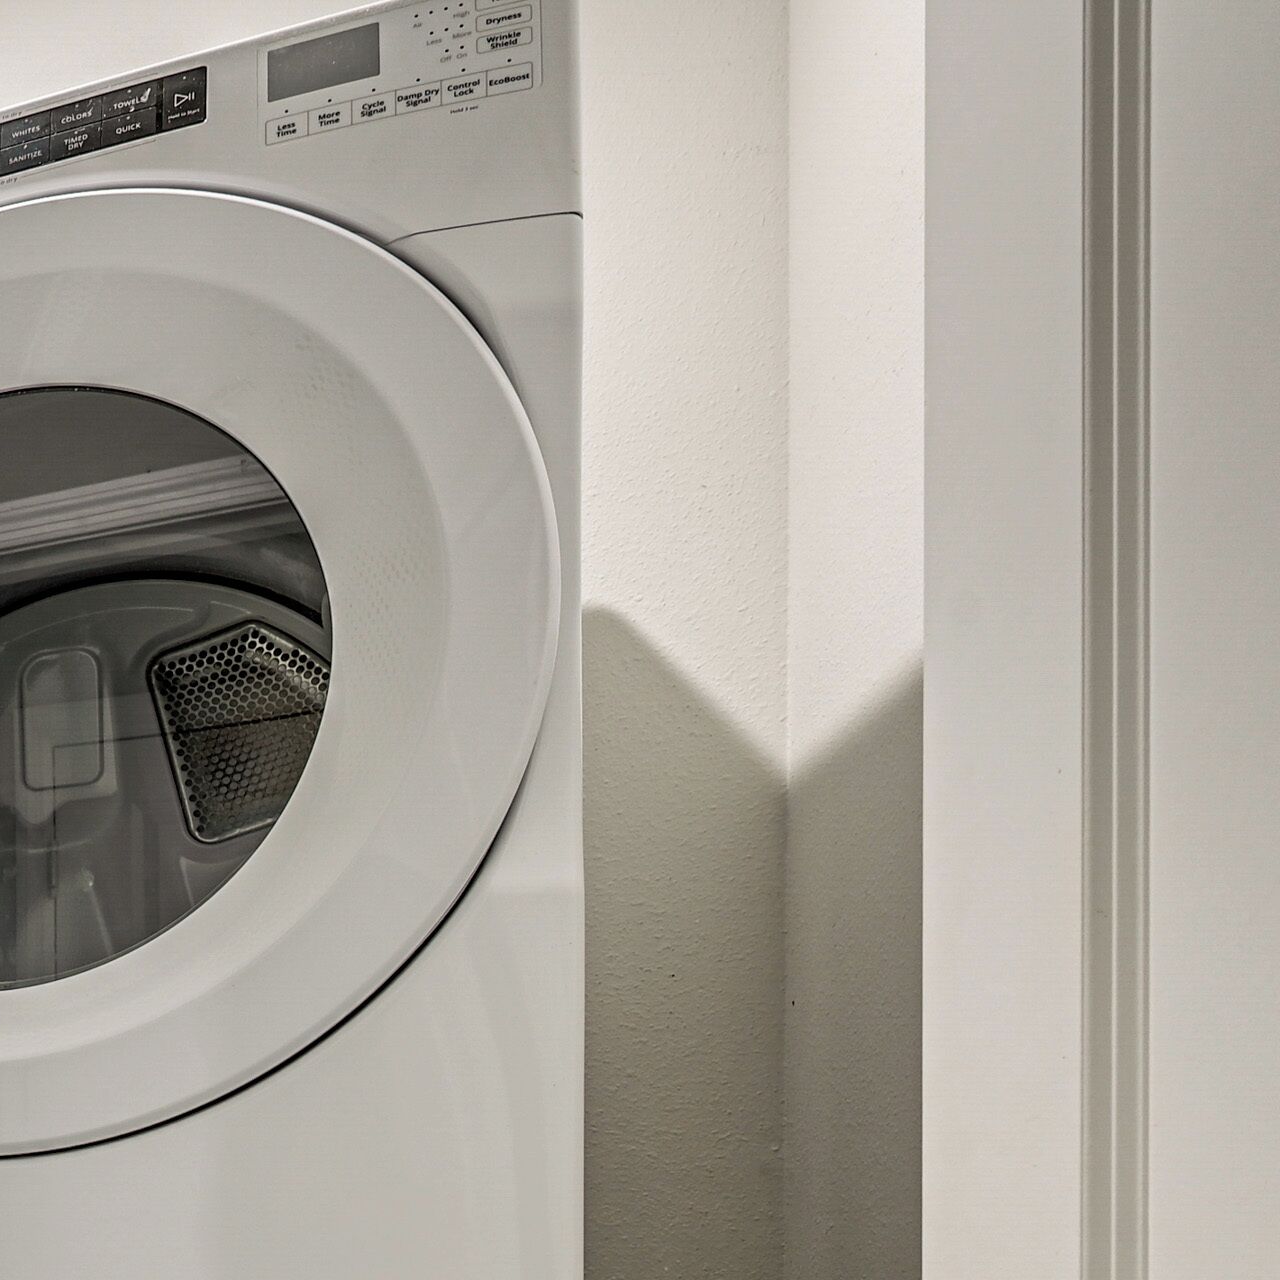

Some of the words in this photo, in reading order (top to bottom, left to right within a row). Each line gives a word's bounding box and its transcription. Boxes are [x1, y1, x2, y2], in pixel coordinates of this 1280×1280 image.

[486, 12, 522, 25] Dryness
[486, 30, 521, 43] Wrinkle
[491, 38, 518, 50] Shield
[447, 79, 481, 92] Control
[489, 73, 530, 87] EcoBoost
[397, 92, 422, 104] Damp
[424, 88, 440, 97] Dry
[453, 88, 474, 98] Lock
[361, 100, 385, 111] Cycle
[405, 96, 431, 107] Signal
[61, 110, 92, 124] COLORS
[318, 110, 340, 120] More
[360, 106, 386, 118] Signal
[277, 122, 296, 131] Less
[319, 118, 340, 127] Time
[11, 125, 40, 138] WHITES
[115, 123, 141, 135] QUICK
[276, 128, 297, 138] Time
[64, 134, 88, 146] TIMED
[68, 141, 84, 151] DRY
[8, 150, 42, 164] SANITIZE
